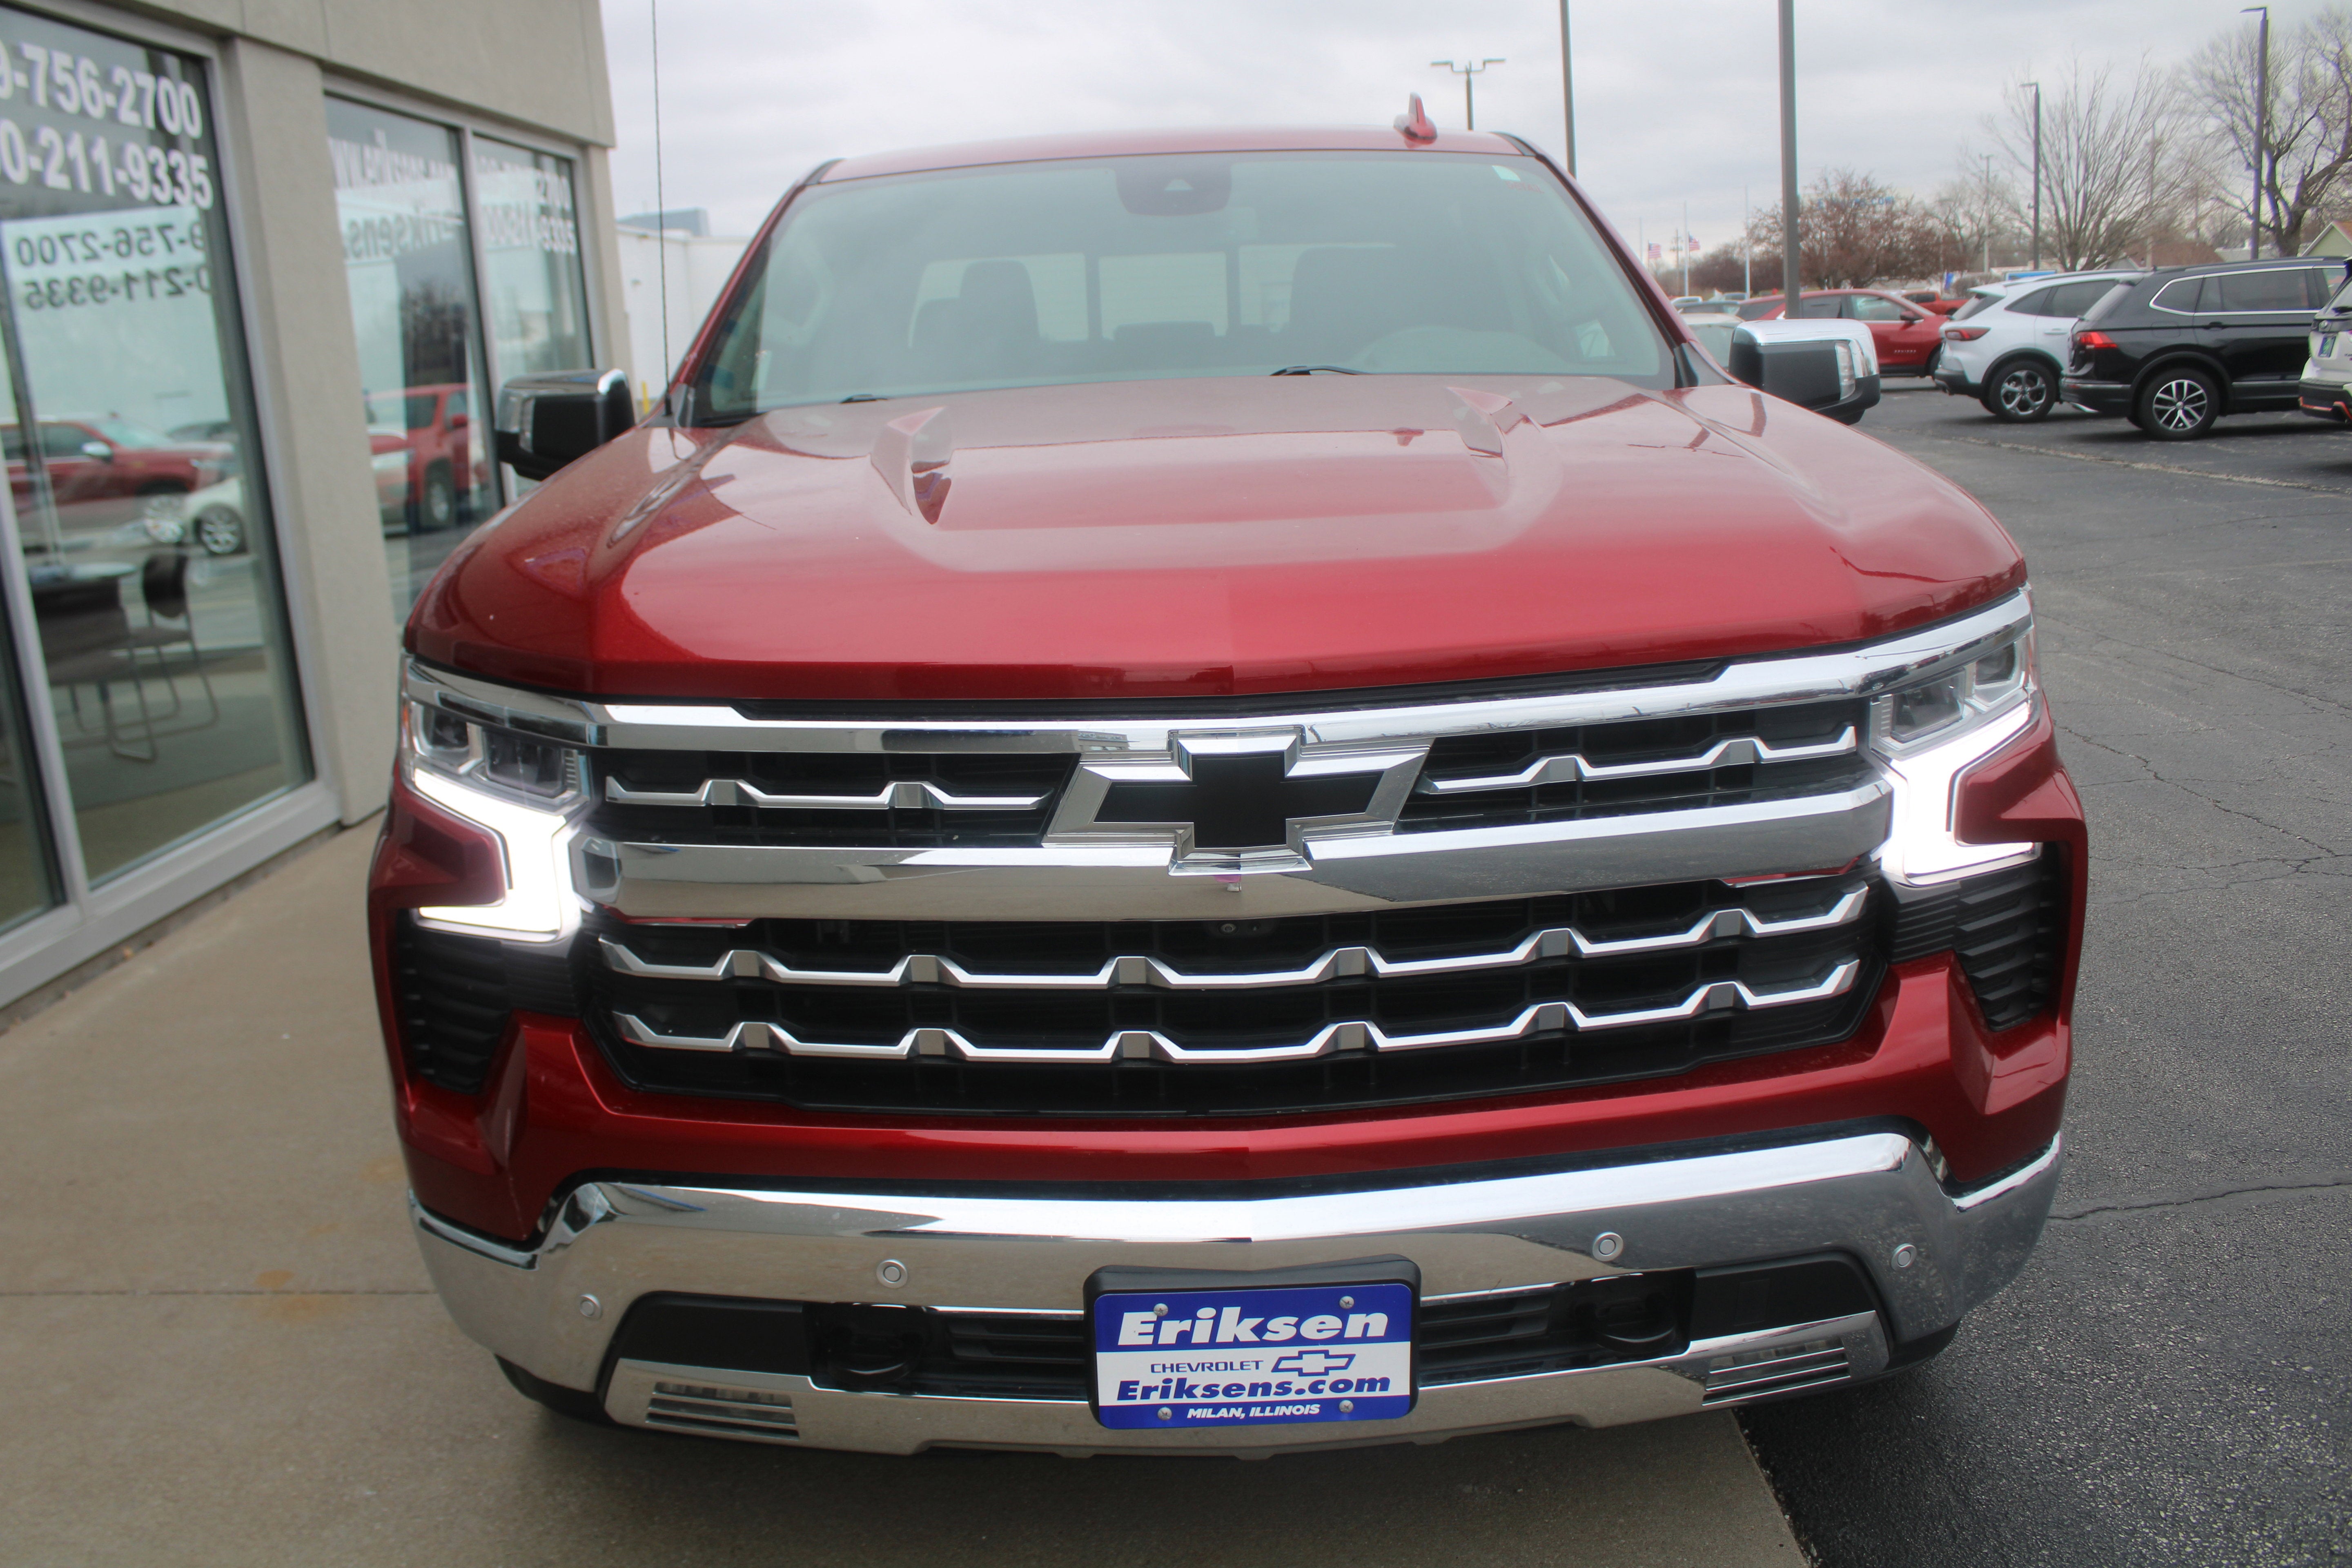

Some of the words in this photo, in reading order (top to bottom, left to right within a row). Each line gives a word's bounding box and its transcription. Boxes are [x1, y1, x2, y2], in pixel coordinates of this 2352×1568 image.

[1117, 1306, 1389, 1346] Eriksen
[1150, 1359, 1264, 1373] CHEVROLET
[1116, 1376, 1391, 1401] Eriksens.com
[1187, 1407, 1245, 1419] MILAN,
[1249, 1403, 1321, 1417] ILLINOIS
